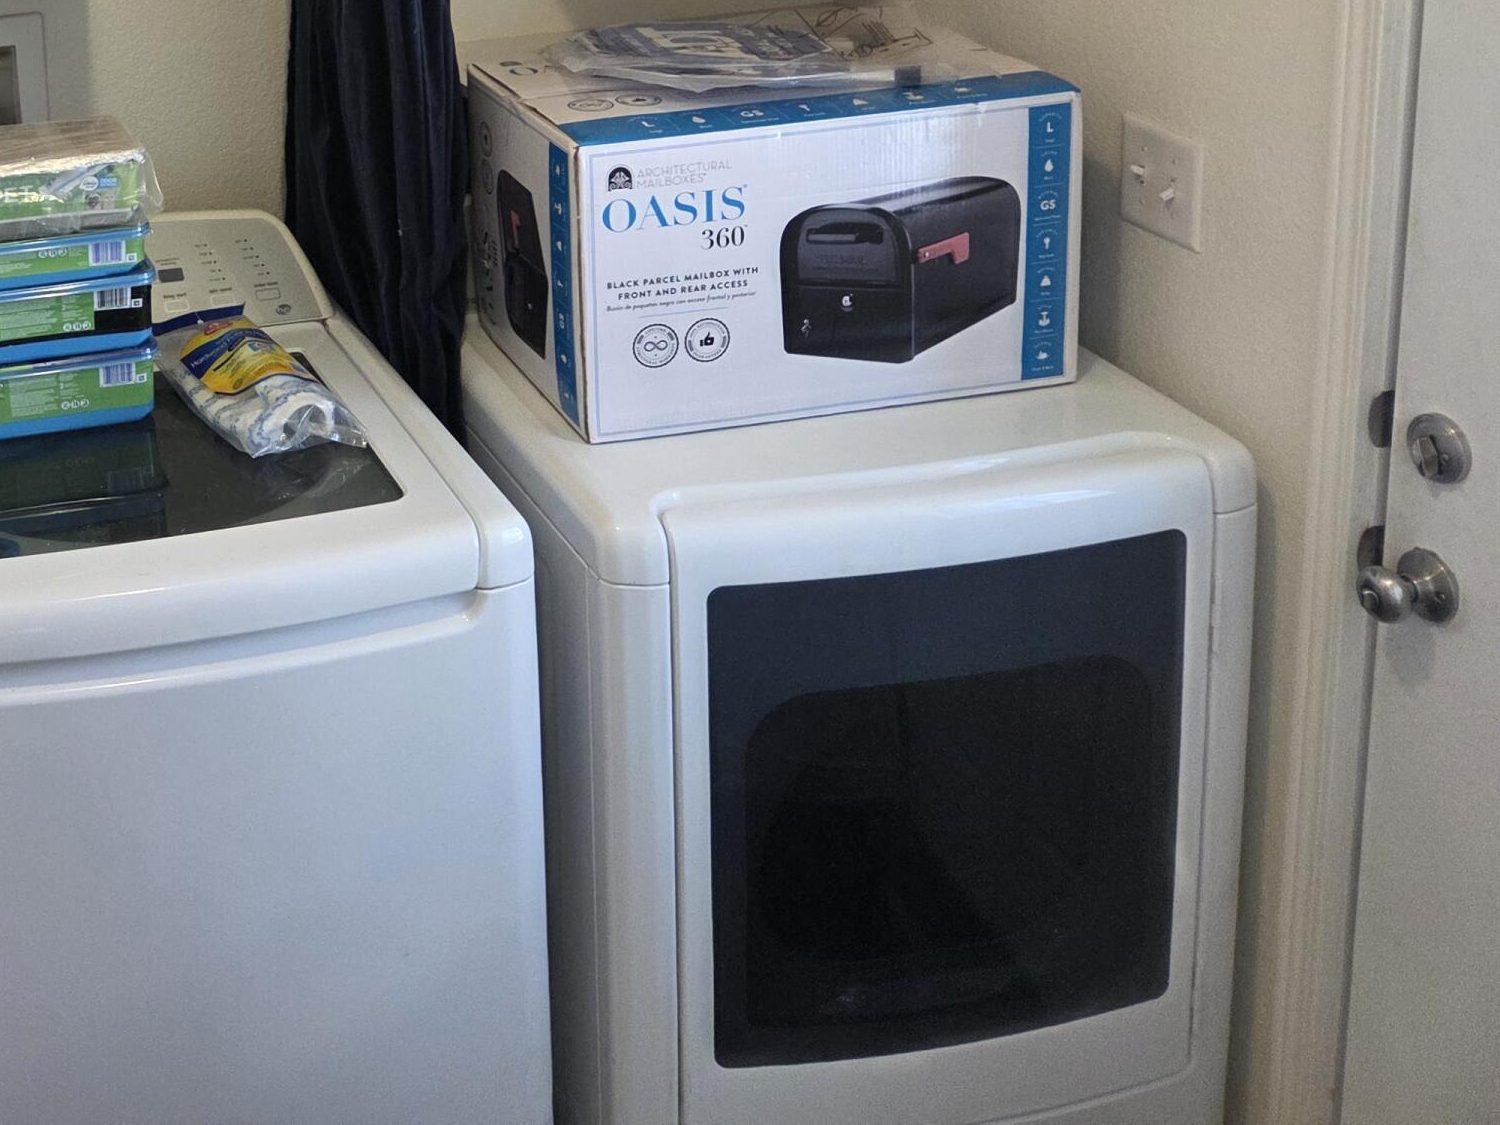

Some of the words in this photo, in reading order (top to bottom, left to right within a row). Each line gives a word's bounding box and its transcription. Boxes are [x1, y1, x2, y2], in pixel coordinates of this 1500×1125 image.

[637, 160, 732, 178] ARCHITECTURAL
[602, 186, 746, 233] OASIS
[1040, 200, 1056, 210] GS
[700, 226, 745, 251] 360
[606, 280, 640, 290] BLACK
[643, 276, 681, 286] PARCEL
[684, 269, 730, 282] MAILBOX
[733, 267, 759, 276] WITH
[618, 290, 652, 301] FRONT
[655, 287, 677, 297] AND
[680, 284, 706, 294] REAR
[710, 279, 748, 291] ACCESS
